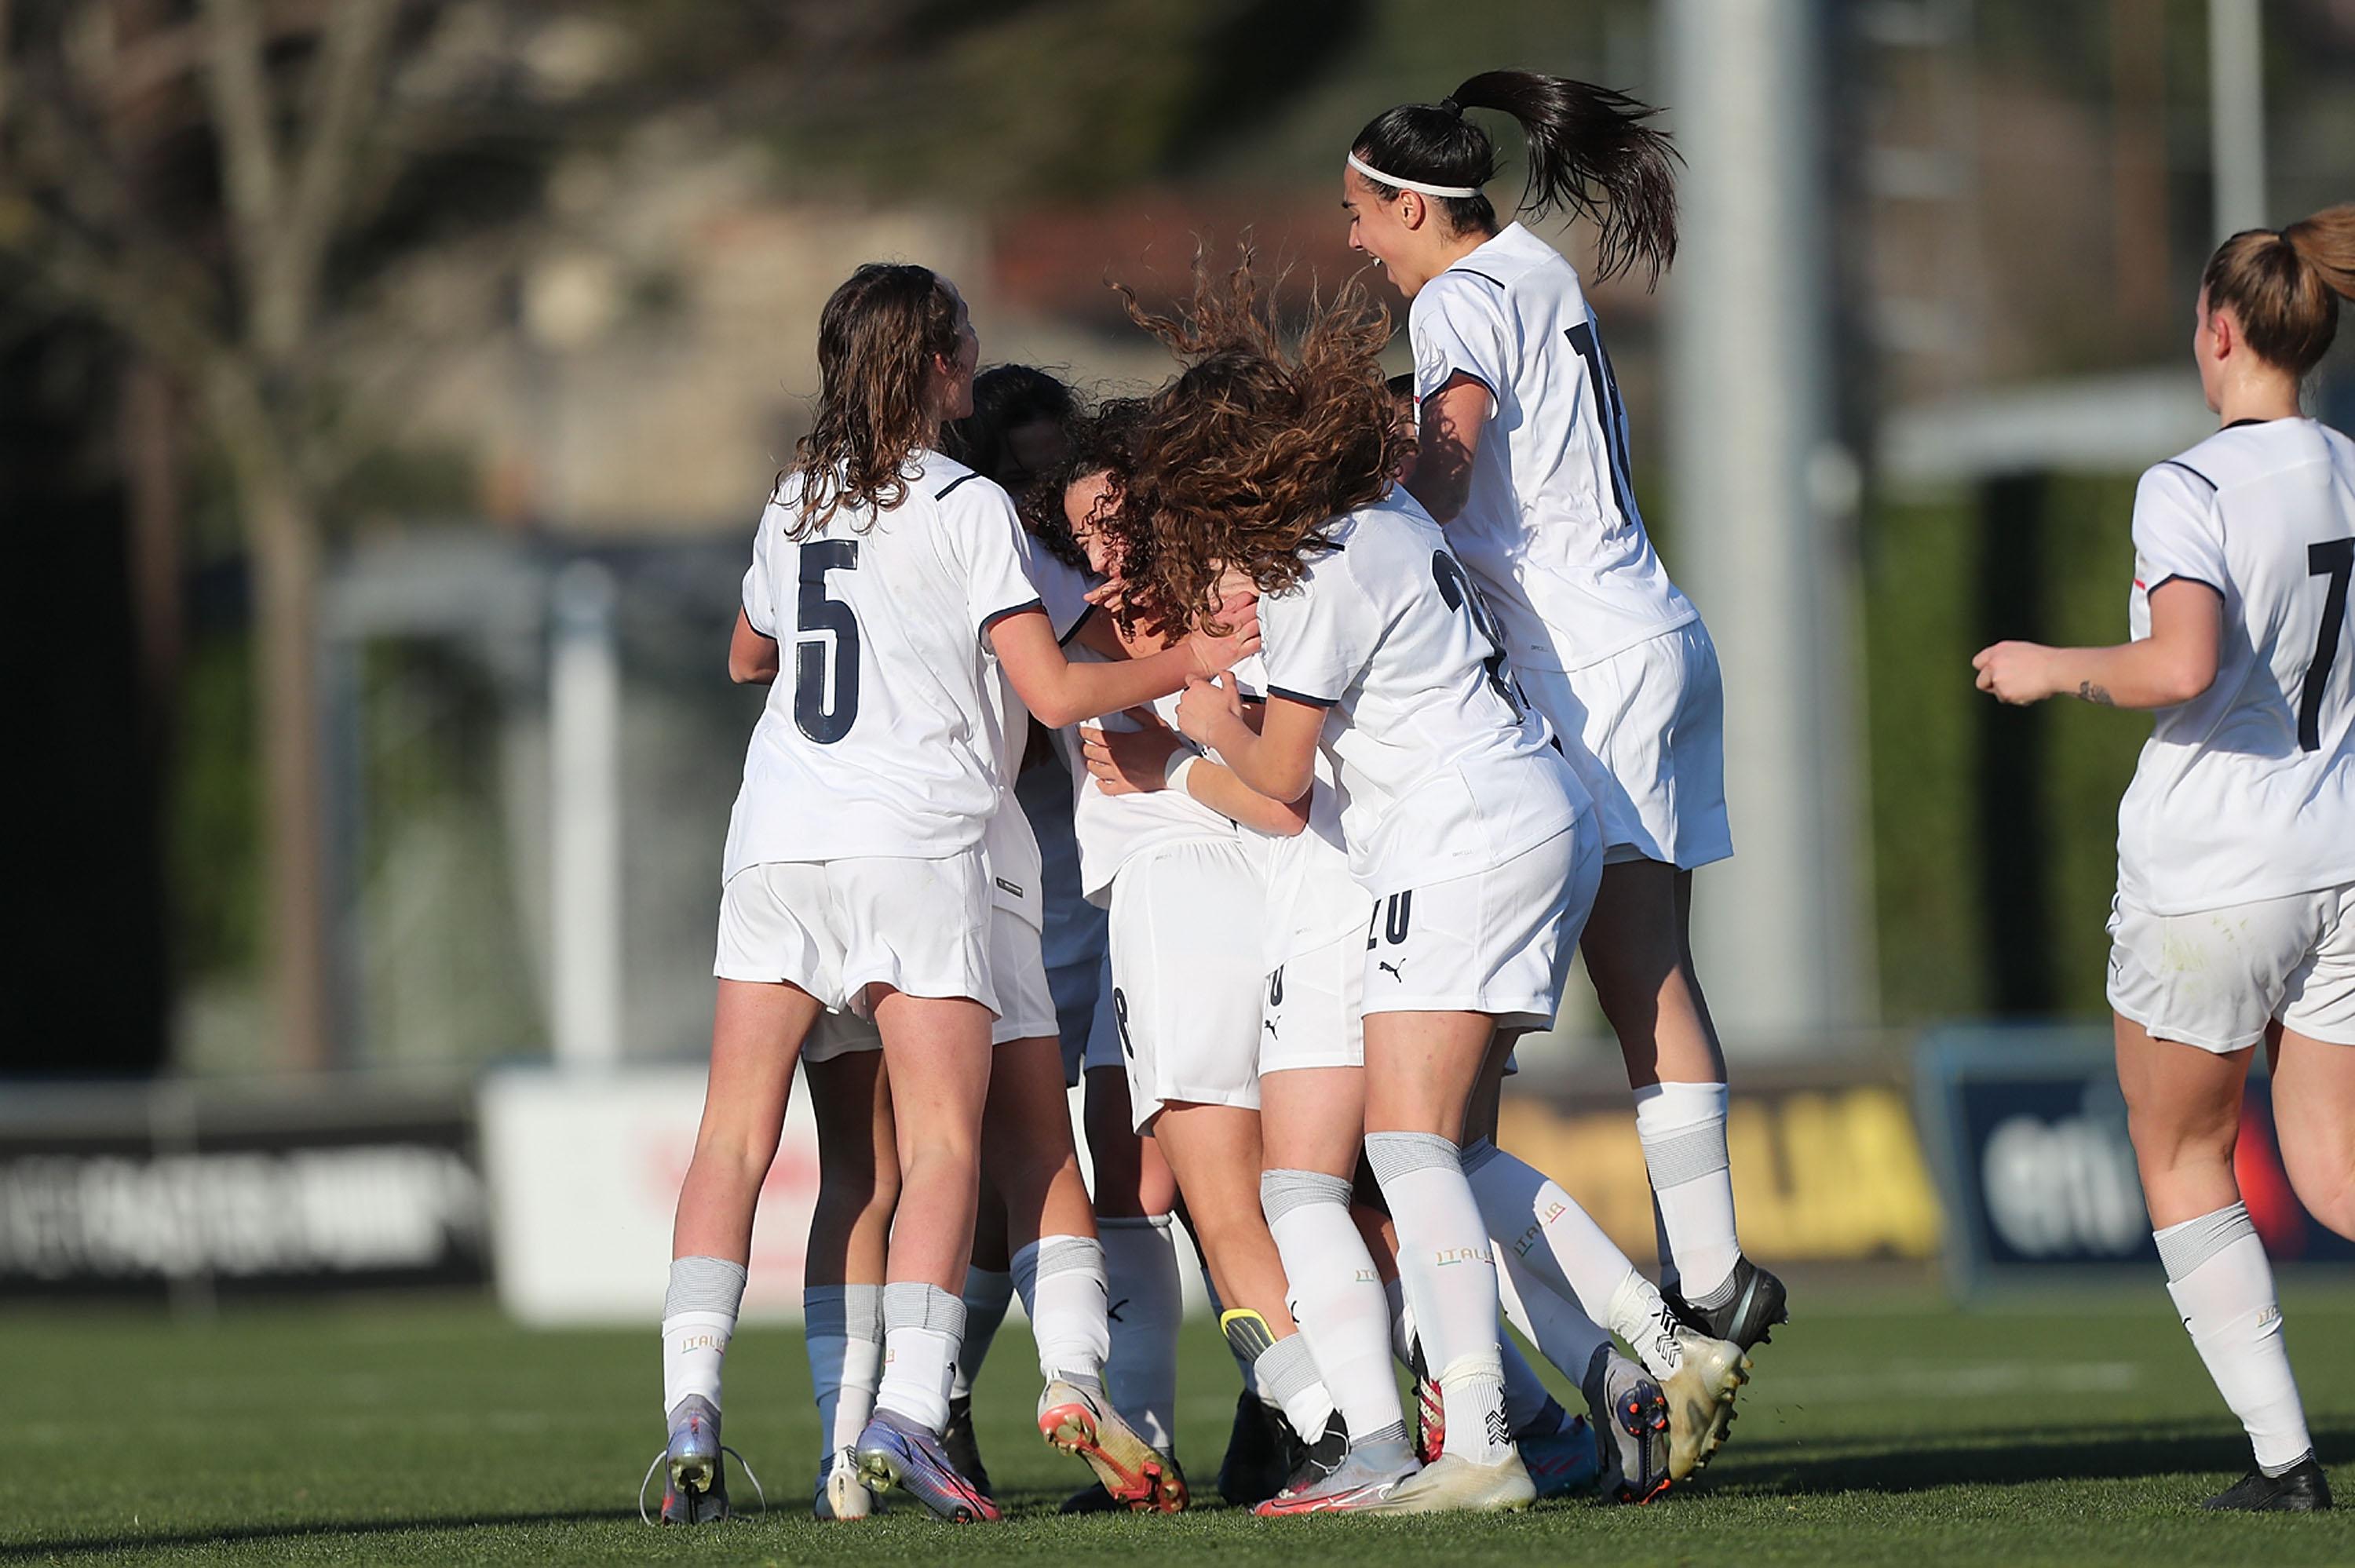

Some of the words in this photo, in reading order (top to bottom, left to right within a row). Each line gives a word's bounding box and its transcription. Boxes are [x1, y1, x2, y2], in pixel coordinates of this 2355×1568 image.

[794, 539, 860, 745] 5
[1432, 549, 1532, 725] 2
[2297, 537, 2355, 752] 7
